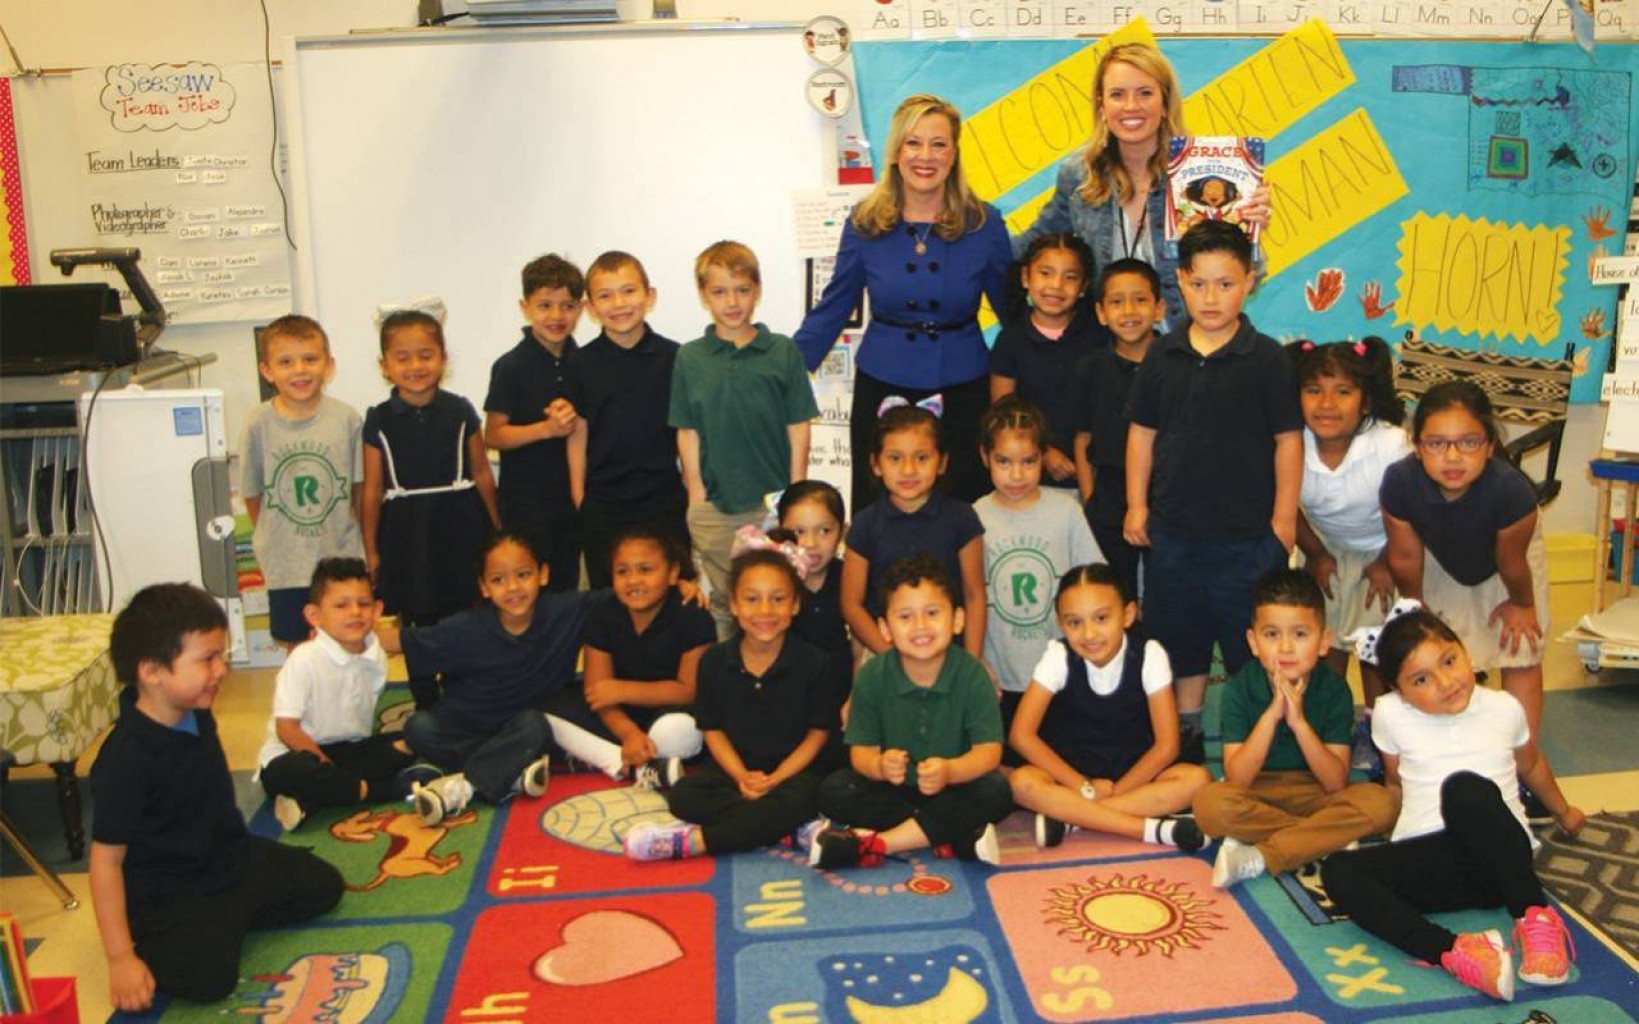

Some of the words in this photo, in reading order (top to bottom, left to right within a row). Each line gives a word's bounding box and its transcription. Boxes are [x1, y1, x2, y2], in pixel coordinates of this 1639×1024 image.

[1556, 8, 1570, 26] P
[116, 64, 215, 96] Seesaw
[1202, 20, 1345, 136] ARTEN
[116, 96, 169, 118] Team
[178, 94, 221, 112] Jobs
[85, 150, 124, 171] Team
[1187, 146, 1244, 158] GRACE
[1181, 164, 1250, 181] PRESIDENT
[1265, 112, 1392, 247] OMAN
[1404, 222, 1560, 327] HORN!
[294, 475, 320, 507] R
[1011, 572, 1038, 606] R
[744, 879, 808, 930] Nn
[460, 991, 531, 1024] h
